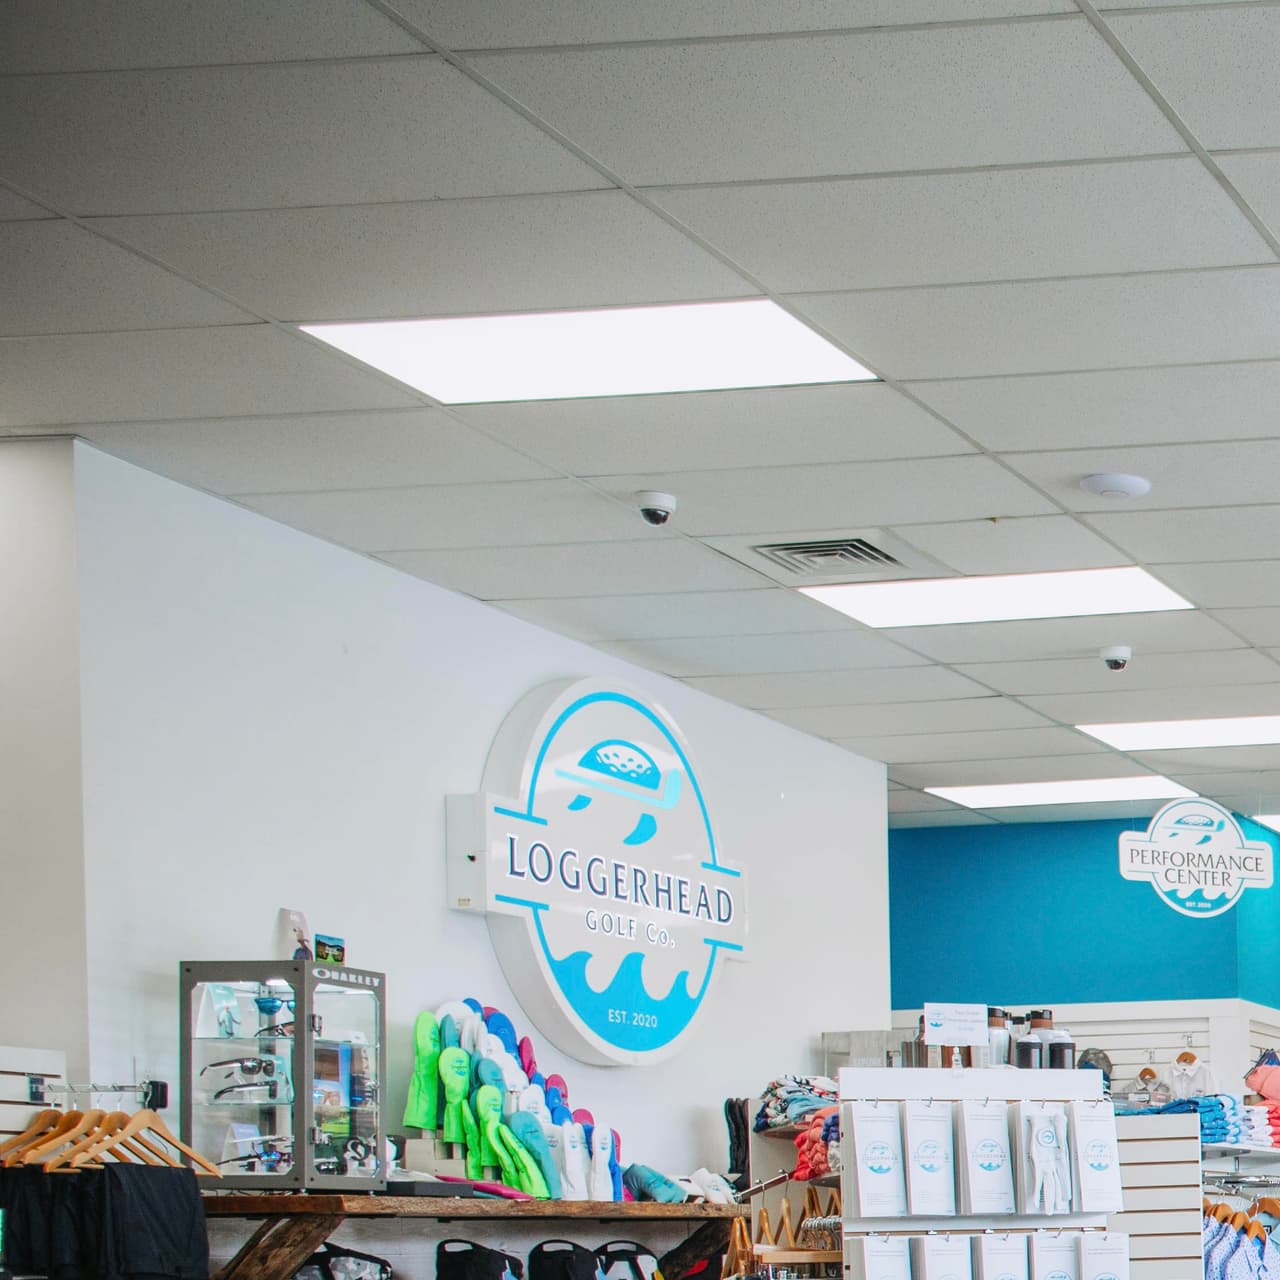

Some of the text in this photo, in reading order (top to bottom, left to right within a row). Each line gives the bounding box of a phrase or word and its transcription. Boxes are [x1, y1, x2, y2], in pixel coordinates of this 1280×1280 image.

[1130, 848, 1265, 873] PERFORMANCE
[507, 834, 735, 925] LOGGERHEAD
[1164, 868, 1233, 888] CENTER
[584, 909, 677, 949] GOLF Co.
[331, 970, 381, 987] OAKLEY
[607, 1008, 659, 1029] EST. 2020
